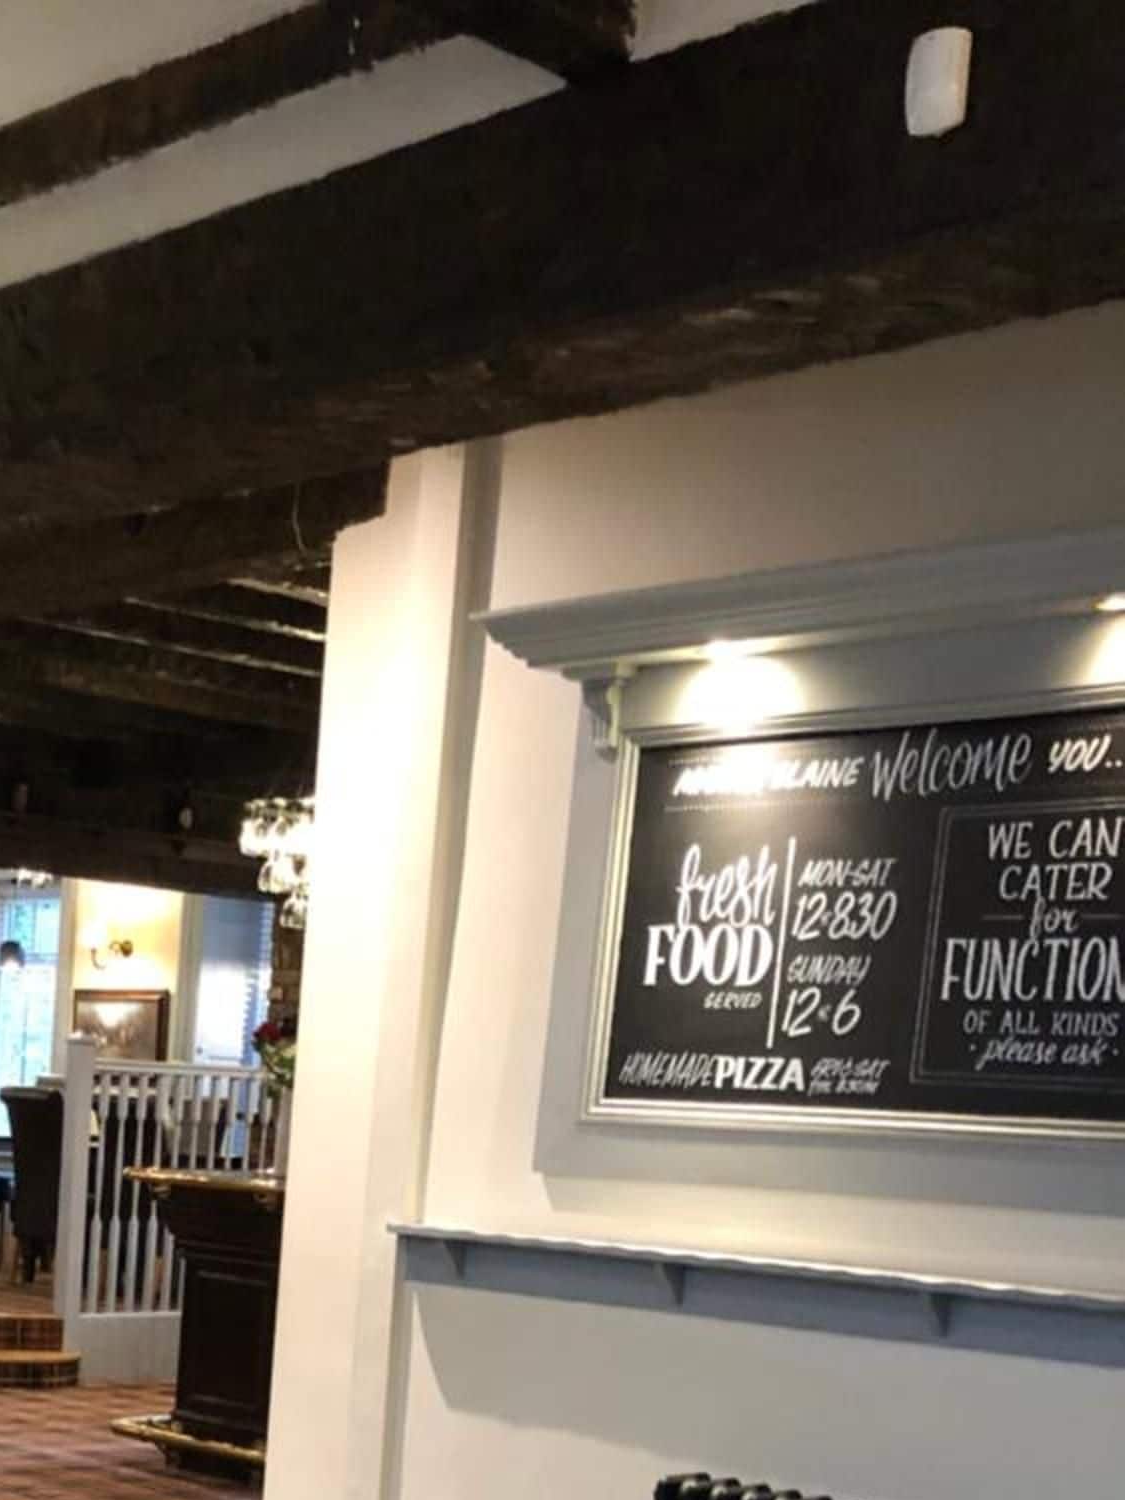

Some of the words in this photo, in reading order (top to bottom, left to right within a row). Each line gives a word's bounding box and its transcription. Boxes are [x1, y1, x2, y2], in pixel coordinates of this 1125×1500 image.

[872, 728, 1031, 802] Welcome
[988, 821, 1033, 861] WE
[1048, 815, 1125, 859] CAN
[675, 843, 777, 929] fresh
[999, 862, 1113, 900] CATER
[1029, 895, 1079, 942] for
[643, 923, 773, 986] FOOD
[786, 954, 873, 986] SUNDAY
[963, 1009, 991, 1033] OF
[1000, 1009, 1040, 1034] ALL
[1051, 1012, 1121, 1037] KINDS
[714, 1055, 805, 1091] PIZZA
[975, 1036, 1057, 1071] please
[1061, 1040, 1107, 1065] ask
